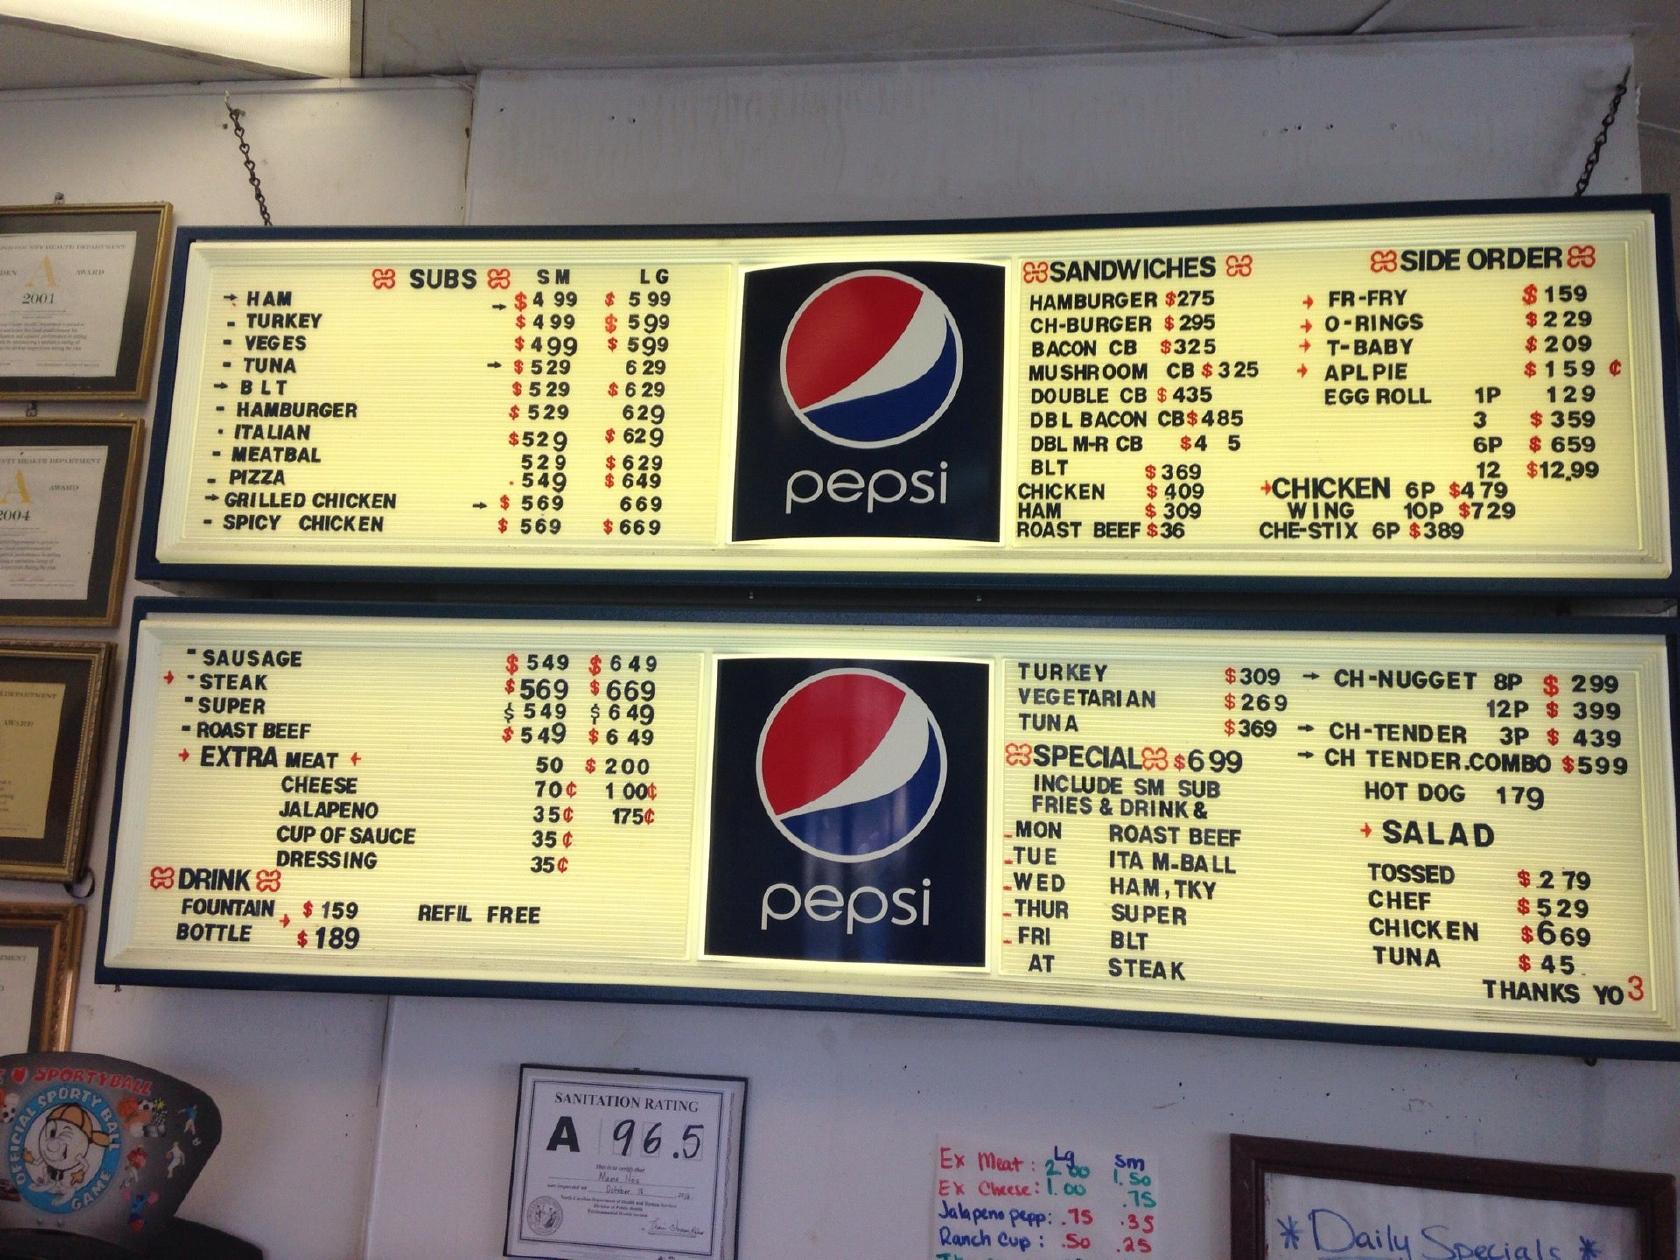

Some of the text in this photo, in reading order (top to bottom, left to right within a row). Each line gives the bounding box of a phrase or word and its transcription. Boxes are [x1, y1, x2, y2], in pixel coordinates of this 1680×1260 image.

[1049, 255, 1217, 283] SANDWICHES
[1399, 246, 1563, 272] SIDE ORDER
[409, 268, 477, 290] SUBS
[246, 290, 292, 307] HAM
[1029, 290, 1215, 311] HAMBURGER $275
[1328, 289, 1408, 308] FR-FRY
[246, 312, 323, 329] TURKEY
[1030, 315, 1152, 334] CH-BURGER
[1324, 313, 1424, 333] O-RINGS
[245, 335, 307, 351] VEGES
[1032, 340, 1097, 358] BACON
[1108, 339, 1137, 356] CB
[1326, 338, 1414, 356] T-BABY
[243, 357, 297, 374] TUNA
[1028, 362, 1195, 382] MUSHROOM CB
[1031, 387, 1147, 404] DOUBLE CB
[1324, 386, 1501, 406] EGG ROLL 1P
[236, 401, 358, 418] HAMBURGER
[1080, 410, 1147, 428] BACON
[1157, 410, 1185, 428] CB
[234, 423, 311, 441] ITALIAN
[1031, 435, 1143, 452] DBL M-R CB
[1473, 436, 1503, 454] 6P
[231, 446, 321, 463] MEATBAL
[229, 469, 285, 486] PIZZA
[1031, 459, 1069, 476] BLT
[1476, 461, 1501, 479] 12
[785, 460, 949, 514] pepsi
[1017, 482, 1105, 500] CHICKEN
[1271, 477, 1436, 500] CHICKEN 6P
[224, 491, 397, 509] GRILLED CHICKEN
[1018, 502, 1062, 520] HAM
[1287, 501, 1355, 520] WING
[223, 514, 384, 532] SPICY CHICKEN
[1017, 521, 1185, 539] ROAST BEEF $36
[1259, 521, 1465, 540] CHE-STIX 6P $389
[202, 648, 303, 668] SAUSAGE
[199, 673, 268, 691] STEAK
[1018, 662, 1108, 682] TURKEY
[1333, 668, 1523, 691] CH-NUGGET 8P
[198, 696, 266, 715] SUPER
[1018, 687, 1156, 708] VEGETARIAN
[1486, 699, 1529, 719] 12P
[196, 721, 312, 740] ROAST BEEF
[1018, 713, 1079, 732] TUNA
[1329, 721, 1530, 746] CH-TENDER 3P
[200, 745, 339, 769] EXTRA MEAT
[1033, 744, 1142, 770] SPECIAL
[1324, 747, 1355, 767] CH
[281, 775, 358, 795] CHEESE
[1034, 774, 1221, 799] INCLUDE SM SUB
[1364, 781, 1545, 811] HOT DOG 179
[278, 800, 379, 820] JALAPENO
[1032, 794, 1208, 820] FRIES & DRINK &
[276, 825, 416, 845] CUP OF SAUCE
[1015, 820, 1242, 847] MON ROAST BEEF
[1382, 819, 1495, 848] SALAD
[276, 850, 378, 870] DRESSING
[1013, 846, 1237, 874] TUE ITA M-BALL
[178, 867, 252, 892] DRINK
[1013, 872, 1066, 893] WED
[1367, 863, 1456, 885] TOSSED
[761, 878, 932, 934] pepsi
[1368, 889, 1431, 911] CHEF
[181, 897, 541, 924] FOUNTAIN REFIL FREE
[1014, 898, 1187, 926] THUR SUPER
[175, 922, 253, 943] BOTTLE
[1018, 926, 1149, 951] FRI BLT
[1368, 917, 1479, 942] CHICKEN
[1372, 945, 1441, 968] TUNA
[1028, 953, 1186, 981] AT STEAK
[1482, 979, 1581, 1005] THANKS
[33, 1067, 152, 1095] SPORTYBALL
[554, 1092, 698, 1113] SANITATION RATING
[547, 1116, 580, 1152] A
[10, 1087, 121, 1210] OFFICIAL SPORTY BALL GAME
[940, 1147, 965, 1169] Ex
[1054, 1146, 1074, 1169] Lg
[938, 1180, 965, 1196] Ex
[939, 1226, 991, 1247] Ranch
[1308, 1209, 1561, 1260] Daily Specials
